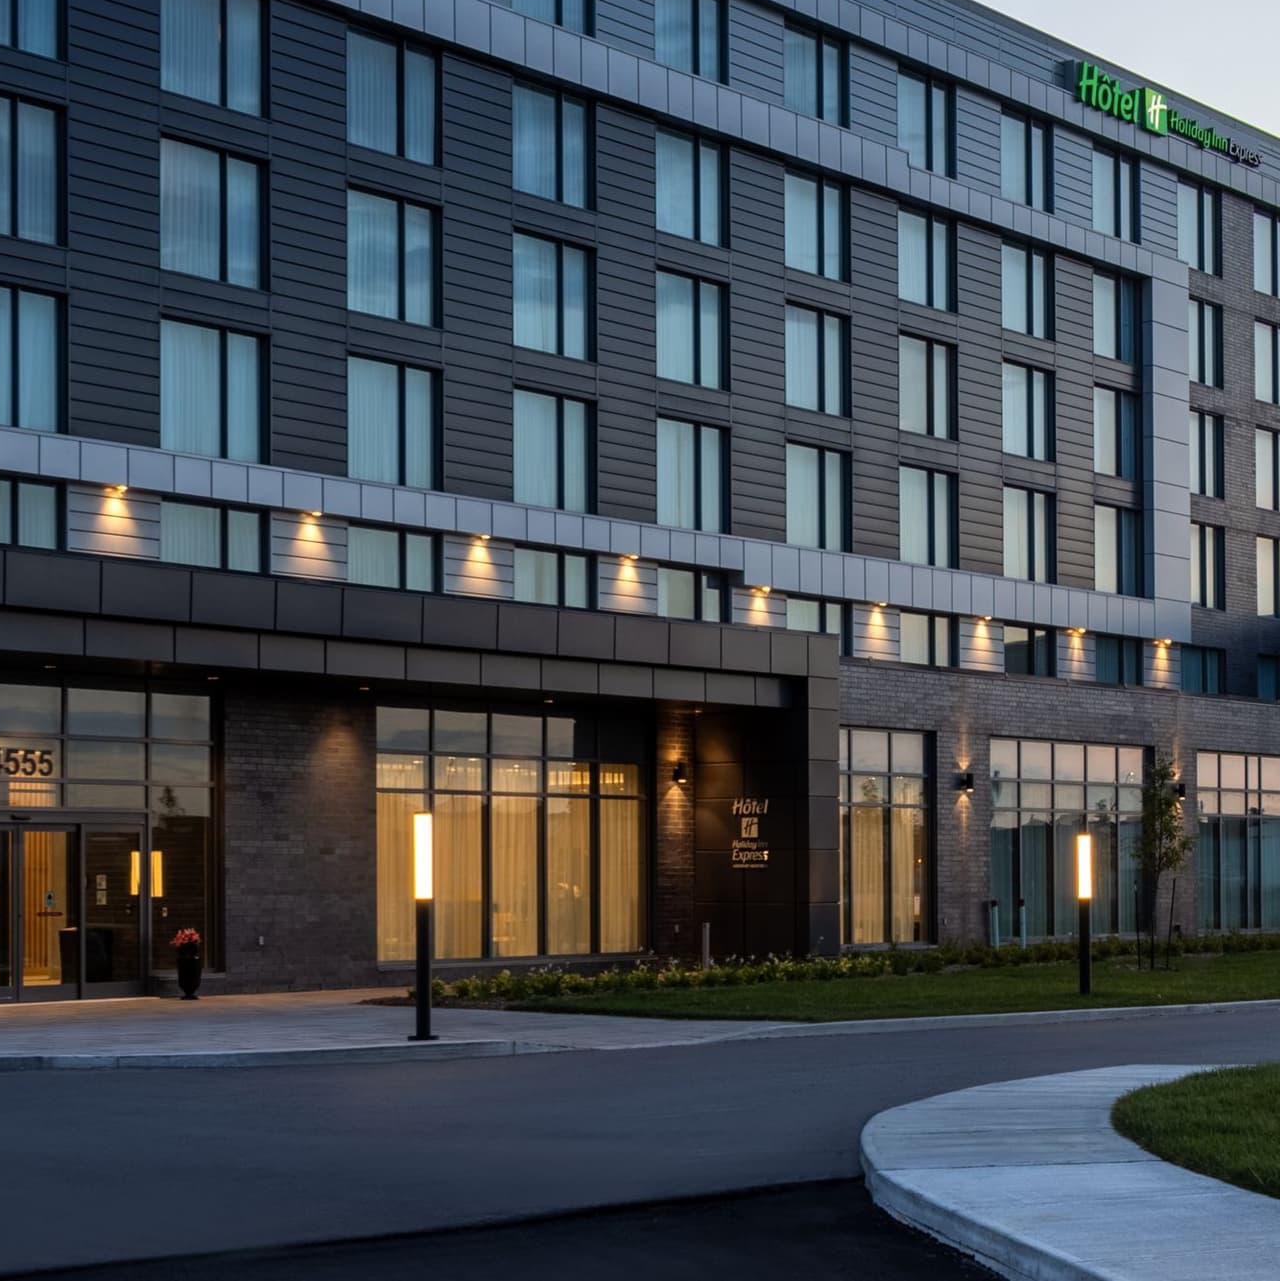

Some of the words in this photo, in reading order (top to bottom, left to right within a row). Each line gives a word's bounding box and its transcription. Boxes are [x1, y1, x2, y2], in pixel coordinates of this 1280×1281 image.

[1078, 61, 1140, 123] Hôtel
[1169, 110, 1211, 149] Holiday
[1211, 127, 1229, 152] Inn
[732, 798, 769, 815] Hôtel
[732, 850, 769, 863] Express
